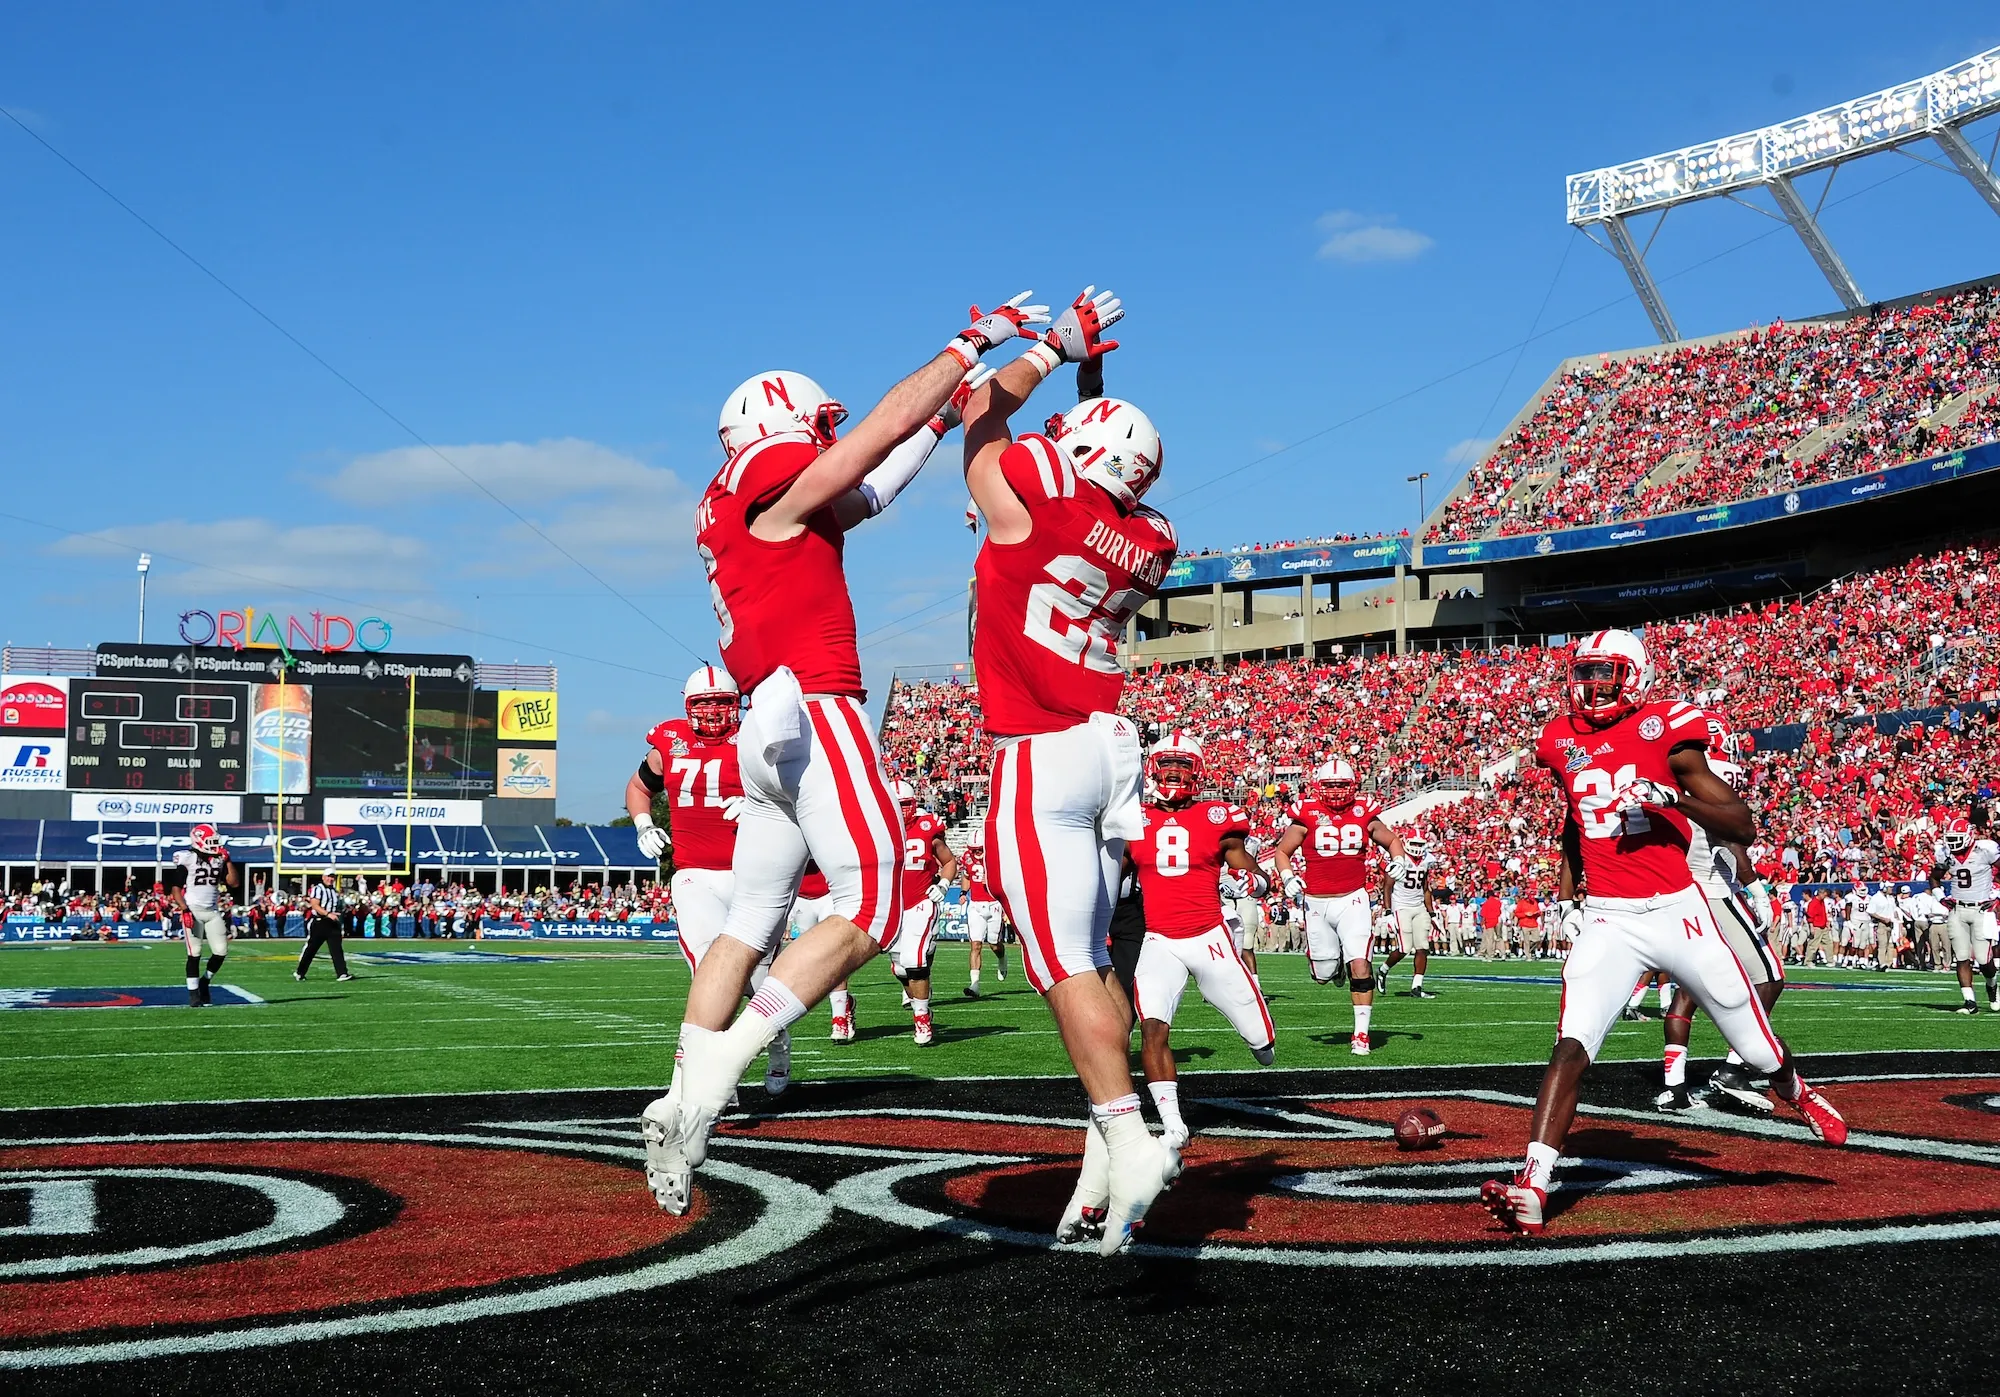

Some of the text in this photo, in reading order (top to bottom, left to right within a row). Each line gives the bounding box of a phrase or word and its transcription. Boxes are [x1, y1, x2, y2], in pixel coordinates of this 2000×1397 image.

[762, 377, 795, 411] N
[1081, 400, 1122, 426] N
[1931, 457, 1963, 471] ORLANDO
[1696, 511, 1728, 523] ORLANDO
[1083, 519, 1163, 587] BURKHEAD
[1353, 545, 1396, 558] ORLANDO
[1447, 546, 1480, 556] ORLANDO
[1166, 567, 1191, 577] ANDO
[1617, 586, 1648, 598] what's
[1649, 586, 1659, 596] in
[1660, 584, 1680, 596] your
[1023, 555, 1149, 674] 22
[178, 605, 393, 668] ORLANDO
[96, 653, 452, 677] FCSports.com FCSports.com CSports.com FCSports.com
[514, 698, 551, 716] TIRES
[261, 715, 310, 728] BUD
[519, 711, 551, 729] PLUS
[71, 756, 99, 766] DOWN
[118, 757, 146, 767] TO GO
[167, 758, 201, 768] BALL ON
[219, 759, 240, 769] QTR.
[2, 768, 63, 777] RUSSELL
[670, 758, 722, 807] 71
[104, 802, 213, 815] FOX SUN SPORTS
[1572, 764, 1651, 839] 21
[366, 805, 446, 818] FOX FLORIDA
[1315, 824, 1363, 857] 68
[417, 851, 480, 859] your
[485, 850, 580, 859] wallet?
[1156, 826, 1190, 877] 8
[1404, 870, 1427, 890] 59
[1956, 868, 1972, 889] 9
[15, 926, 130, 939] VENTE
[542, 924, 643, 937] VENTURE
[1682, 916, 1703, 940] N
[1207, 943, 1226, 962] N
